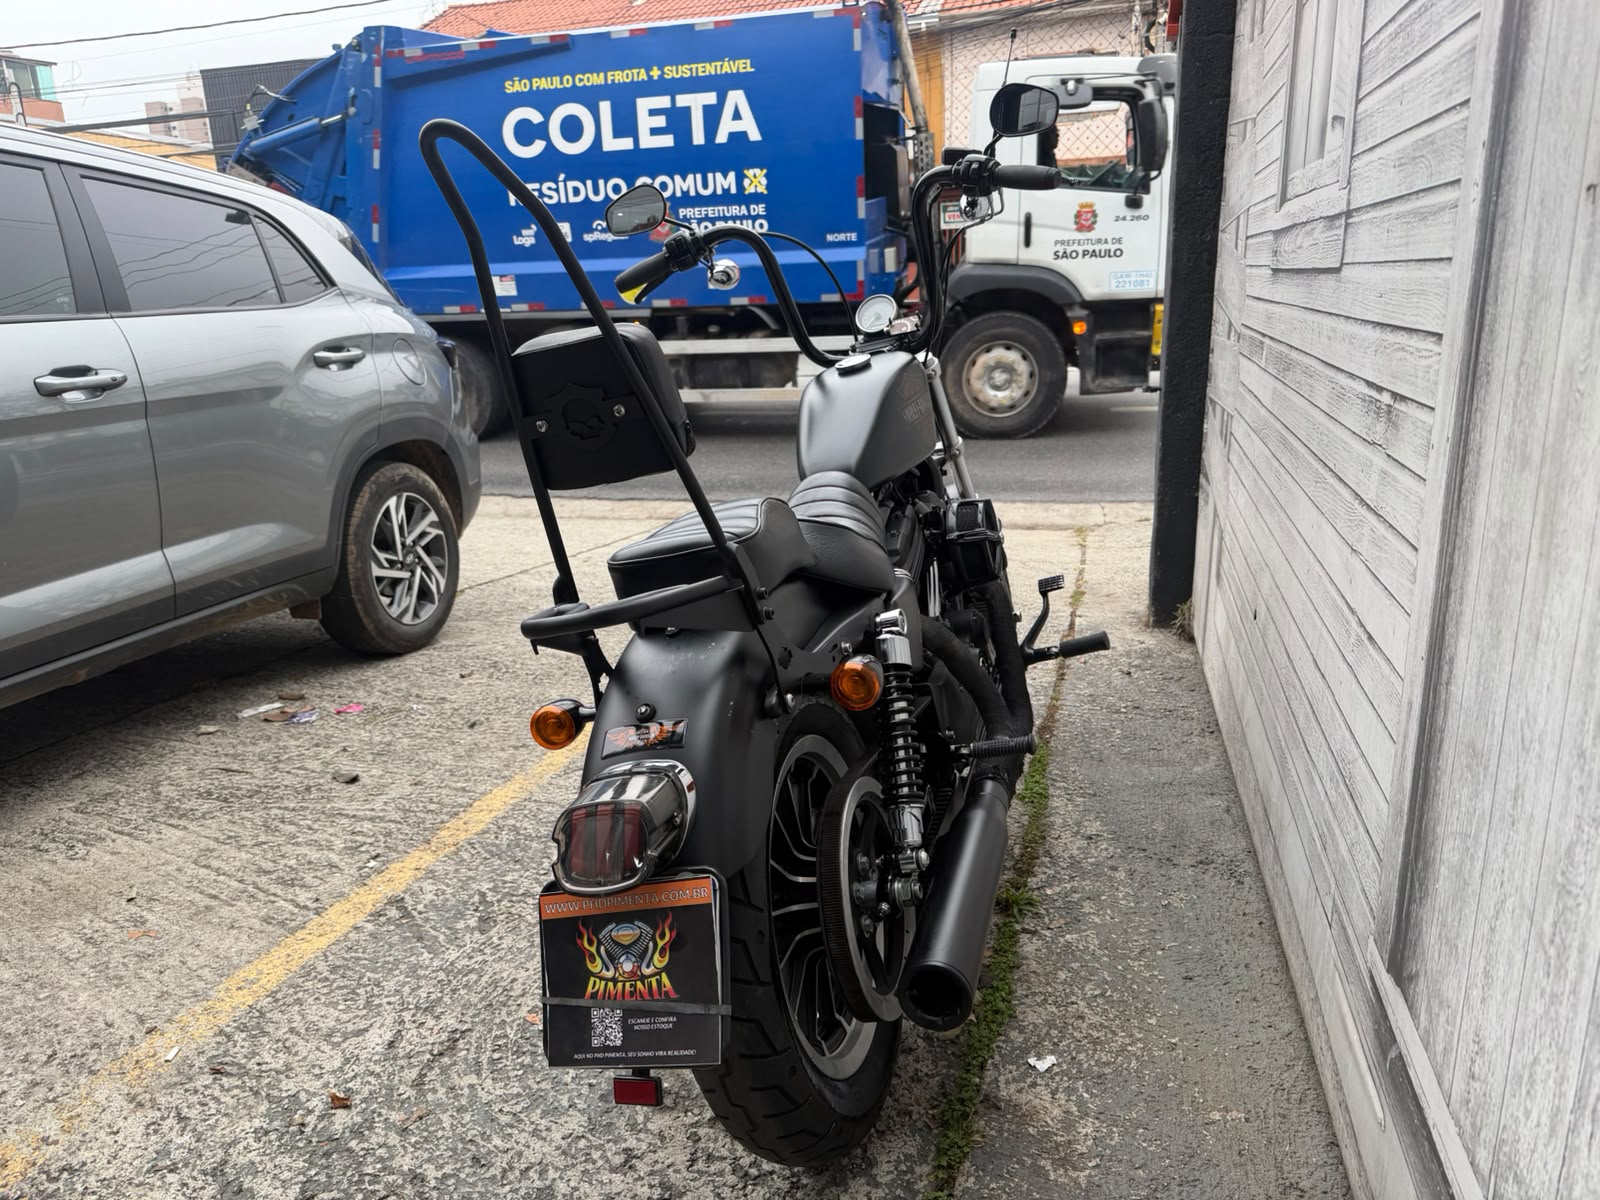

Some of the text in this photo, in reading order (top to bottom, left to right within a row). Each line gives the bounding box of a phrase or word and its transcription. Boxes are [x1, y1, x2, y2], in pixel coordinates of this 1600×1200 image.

[504, 77, 530, 93] SÃO
[532, 75, 573, 91] PAULO
[575, 72, 605, 87] COM
[607, 68, 648, 84] FROTA
[663, 57, 755, 79] SUSTENTÁVEL
[502, 89, 762, 159] COLETA
[635, 171, 737, 198] OMUM
[678, 204, 766, 219] PREFEITURA DE
[1113, 214, 1150, 222] 24.260
[826, 232, 858, 242] NORTE
[1054, 237, 1123, 247] PREFEITURA DE
[1053, 247, 1124, 260] SÃO PAULO
[544, 887, 709, 914] WWW.PHDPIMENTA.COM.BR
[584, 972, 680, 1001] PIMENTA
